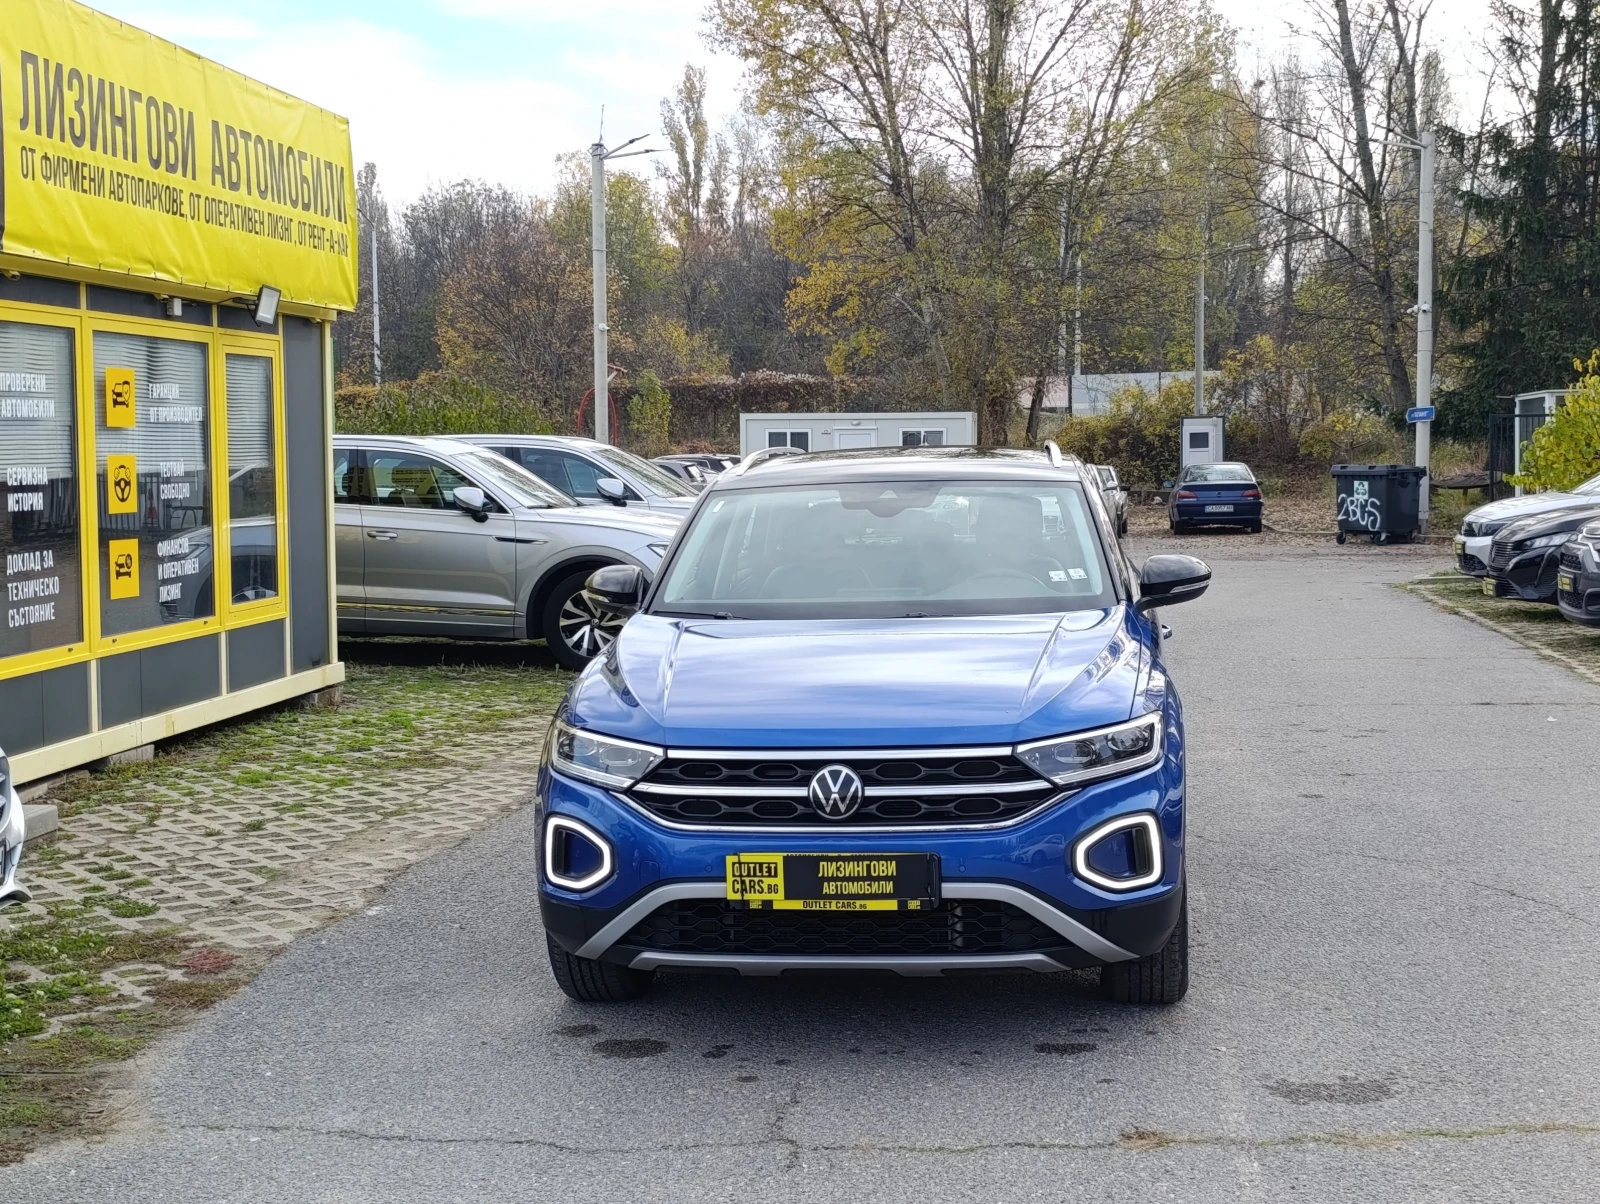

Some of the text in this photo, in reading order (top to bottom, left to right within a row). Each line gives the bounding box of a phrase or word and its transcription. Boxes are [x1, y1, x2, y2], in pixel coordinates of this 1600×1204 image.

[20, 50, 348, 225] ЛИЗИНГОВИ АВТОМОБИЛИ
[20, 145, 36, 181] ОТ
[40, 152, 105, 198] ФИРМЕНИ
[109, 170, 188, 222] АВТОПАРКОВЕ,
[189, 192, 202, 222] ОТ
[204, 196, 265, 237] ОПЕРАТИВЕН
[298, 220, 307, 246] ОТ
[0, 372, 46, 392] ПРОВЕРЕНИ
[1, 398, 55, 418] АВТОМОБИЛИ
[150, 406, 158, 422] ОТ
[7, 466, 48, 486] СЕРВИЗНА
[160, 458, 184, 477] ТЕСТВАЙ
[160, 482, 190, 500] СВОБОДНО
[7, 492, 44, 512] ИСТОРИЯ
[157, 537, 189, 557] ФИНАНСОВ
[7, 549, 54, 576] ДОКЛАД ЗА
[157, 557, 199, 580] И ОПЕРАТИВЕН
[7, 576, 60, 601] ТЕХНИЧЕСКО
[159, 582, 182, 603] ЛИЗИНГ
[8, 602, 56, 628] СЪСТОЯНИЕ
[733, 863, 777, 877] OUTLET
[818, 861, 897, 878] ЛИЗИНГОВИ
[732, 878, 779, 895] CARS.BG
[822, 881, 894, 895] АВТОМОБИЛИ
[802, 900, 867, 910] OUTLET CARS.BG
